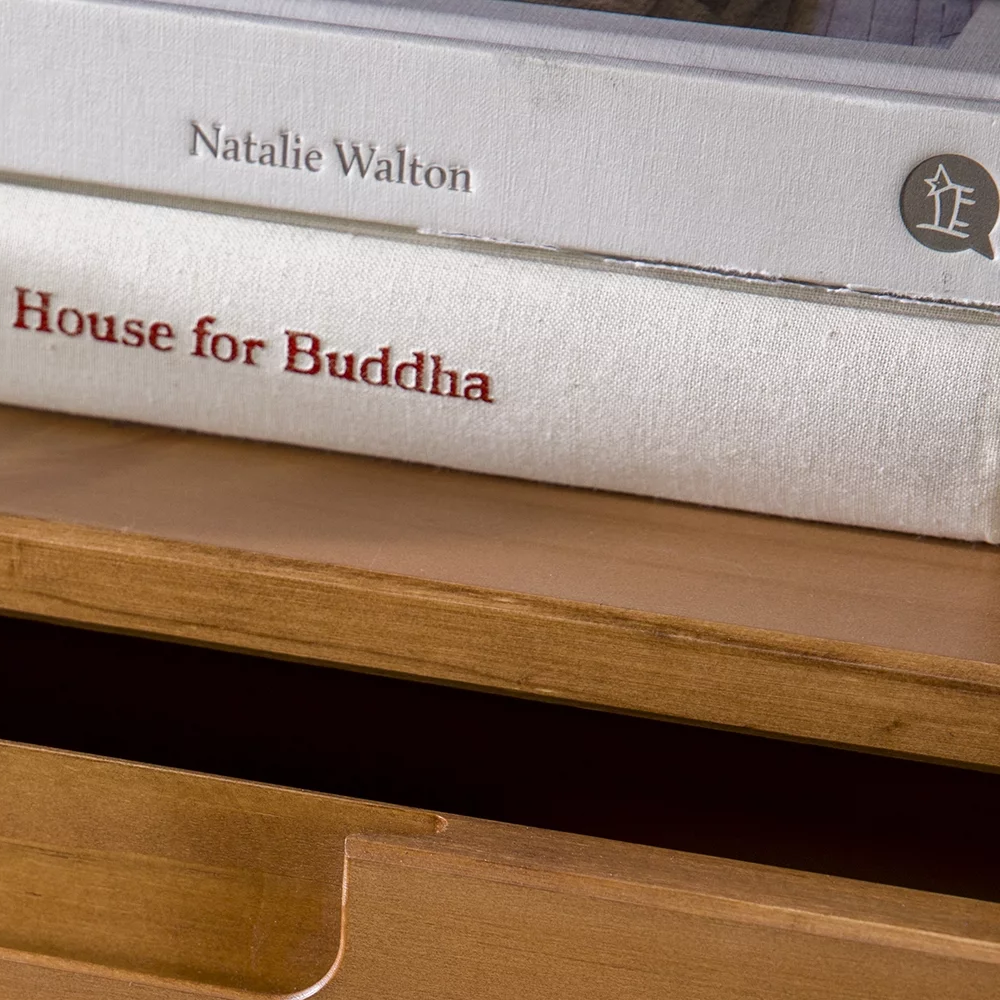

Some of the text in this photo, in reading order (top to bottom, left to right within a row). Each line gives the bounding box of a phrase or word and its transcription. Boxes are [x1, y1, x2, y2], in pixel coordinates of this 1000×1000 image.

[188, 118, 473, 194] Natalie Walton
[12, 286, 177, 354] House
[190, 315, 270, 369] for
[283, 329, 498, 406] Buddha
